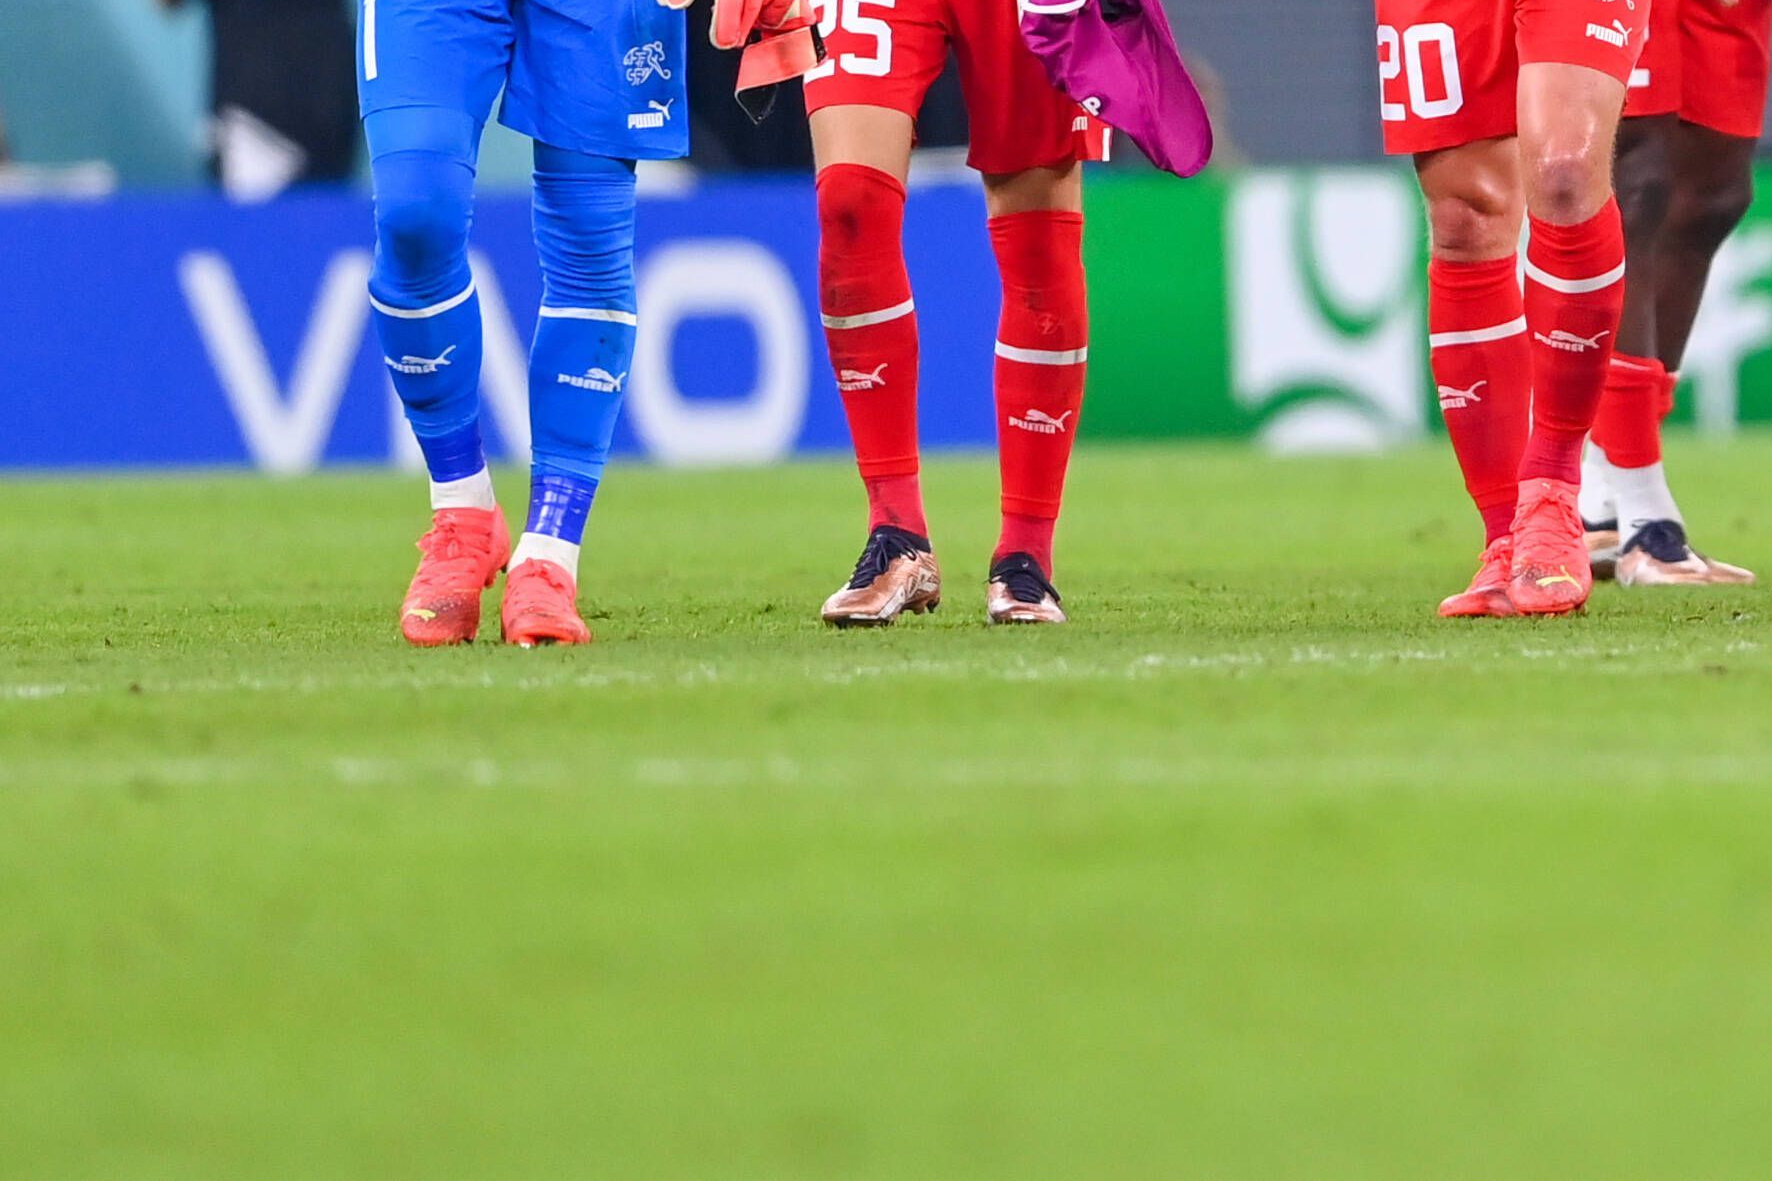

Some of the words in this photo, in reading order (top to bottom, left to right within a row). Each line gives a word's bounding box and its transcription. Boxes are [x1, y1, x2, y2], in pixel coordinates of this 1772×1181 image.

[1585, 22, 1624, 48] PUMA
[1376, 22, 1464, 121] 20
[627, 112, 664, 129] PUMA
[557, 372, 616, 393] PUMA
[1008, 416, 1056, 435] PUMA
